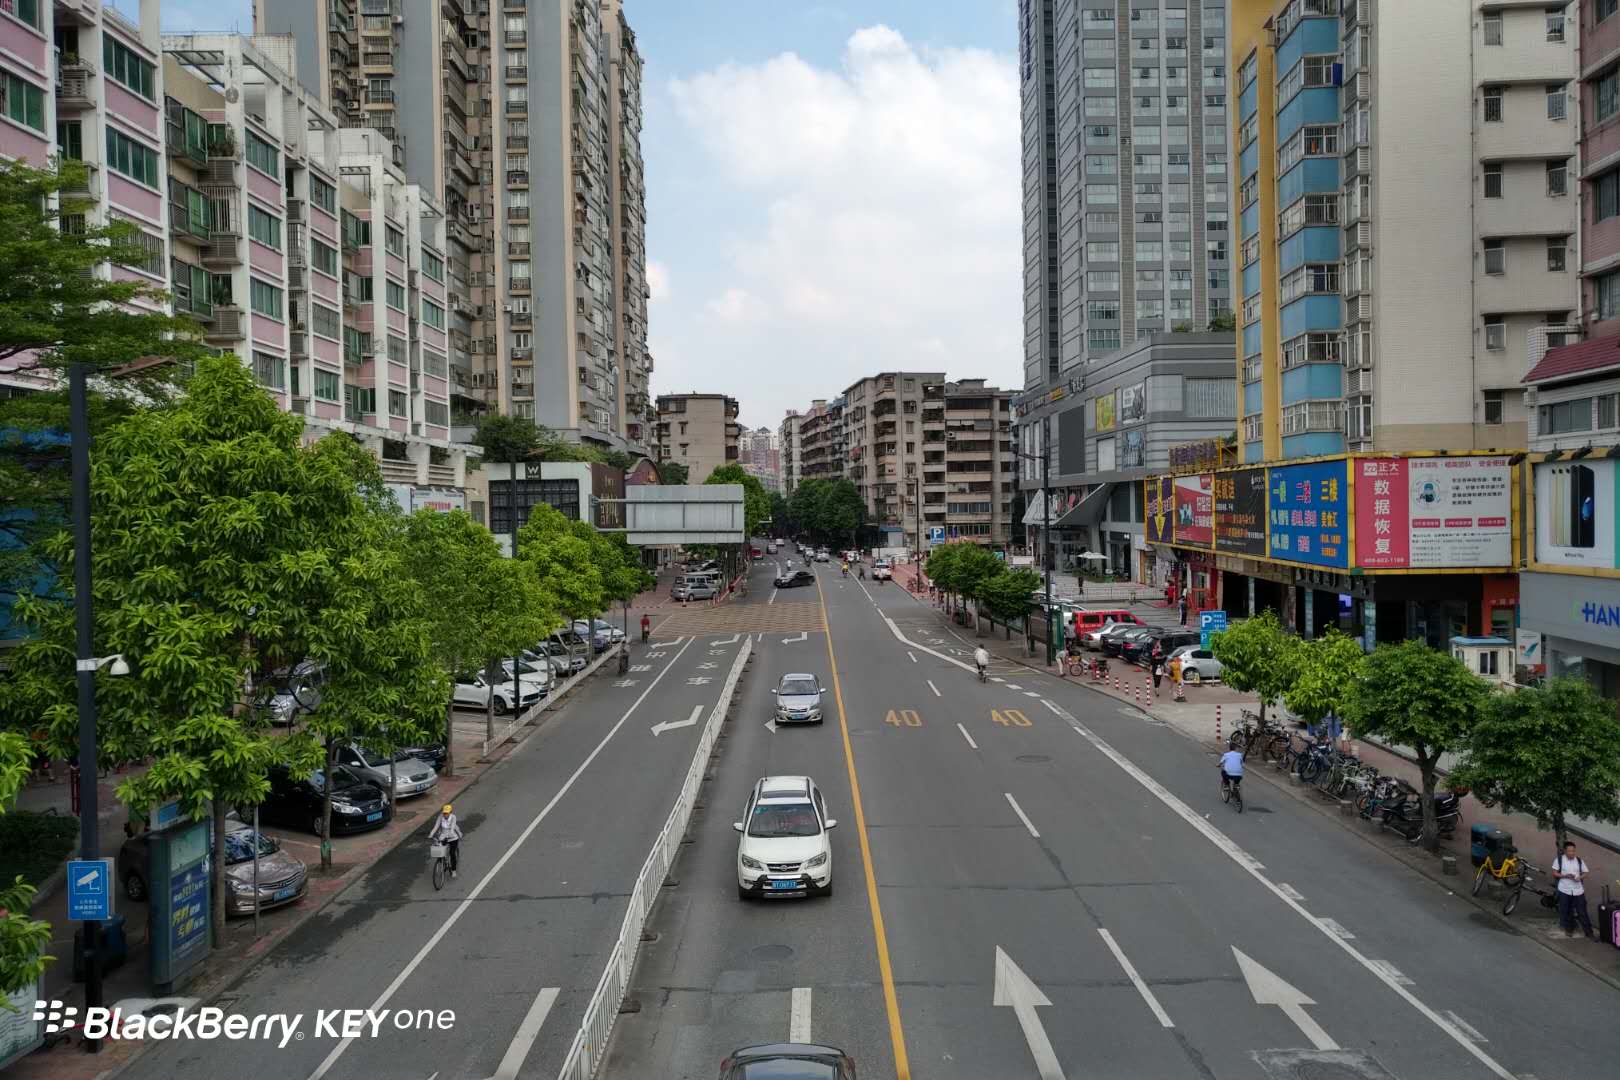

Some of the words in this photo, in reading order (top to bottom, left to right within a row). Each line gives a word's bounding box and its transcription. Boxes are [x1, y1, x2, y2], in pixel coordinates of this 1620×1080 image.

[1374, 479, 1391, 554] 数据恢复
[933, 528, 942, 539] P
[1201, 615, 1212, 628] P
[885, 709, 922, 727] 40
[991, 709, 1032, 727] 40
